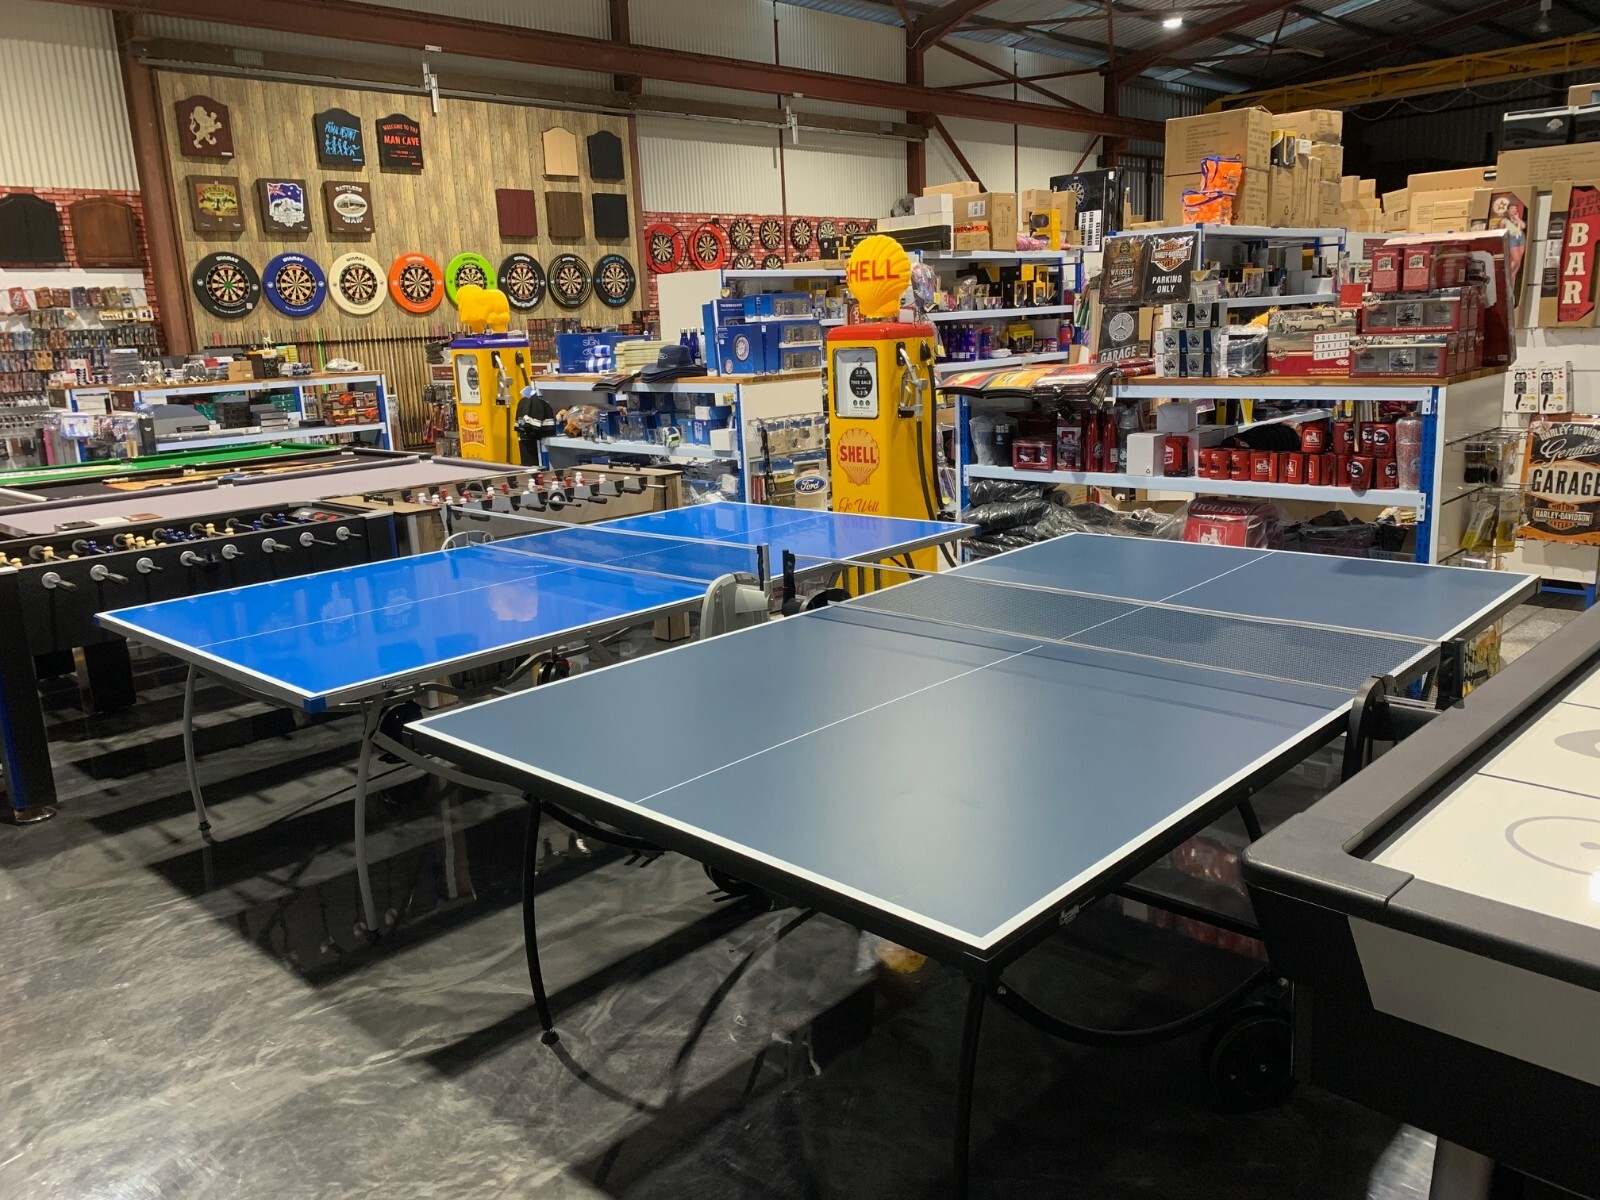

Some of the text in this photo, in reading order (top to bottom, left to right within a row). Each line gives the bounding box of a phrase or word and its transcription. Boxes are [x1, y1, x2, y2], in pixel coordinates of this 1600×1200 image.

[384, 135, 420, 146] MAN CAVE
[847, 259, 900, 283] HELL
[1562, 222, 1590, 305] BAR
[1152, 275, 1182, 284] PARKING
[1157, 285, 1175, 293] ONLY
[582, 339, 600, 347] SIGN
[1101, 346, 1137, 362] GARAGE
[839, 445, 877, 465] SHELL
[1540, 439, 1600, 468] Genuine
[800, 478, 820, 491] Ford
[1531, 469, 1600, 497] GARAGE
[838, 496, 880, 513] Go Well
[1192, 502, 1250, 515] HOLDEN
[1535, 509, 1591, 523] HARLEY-DAVIDSON
